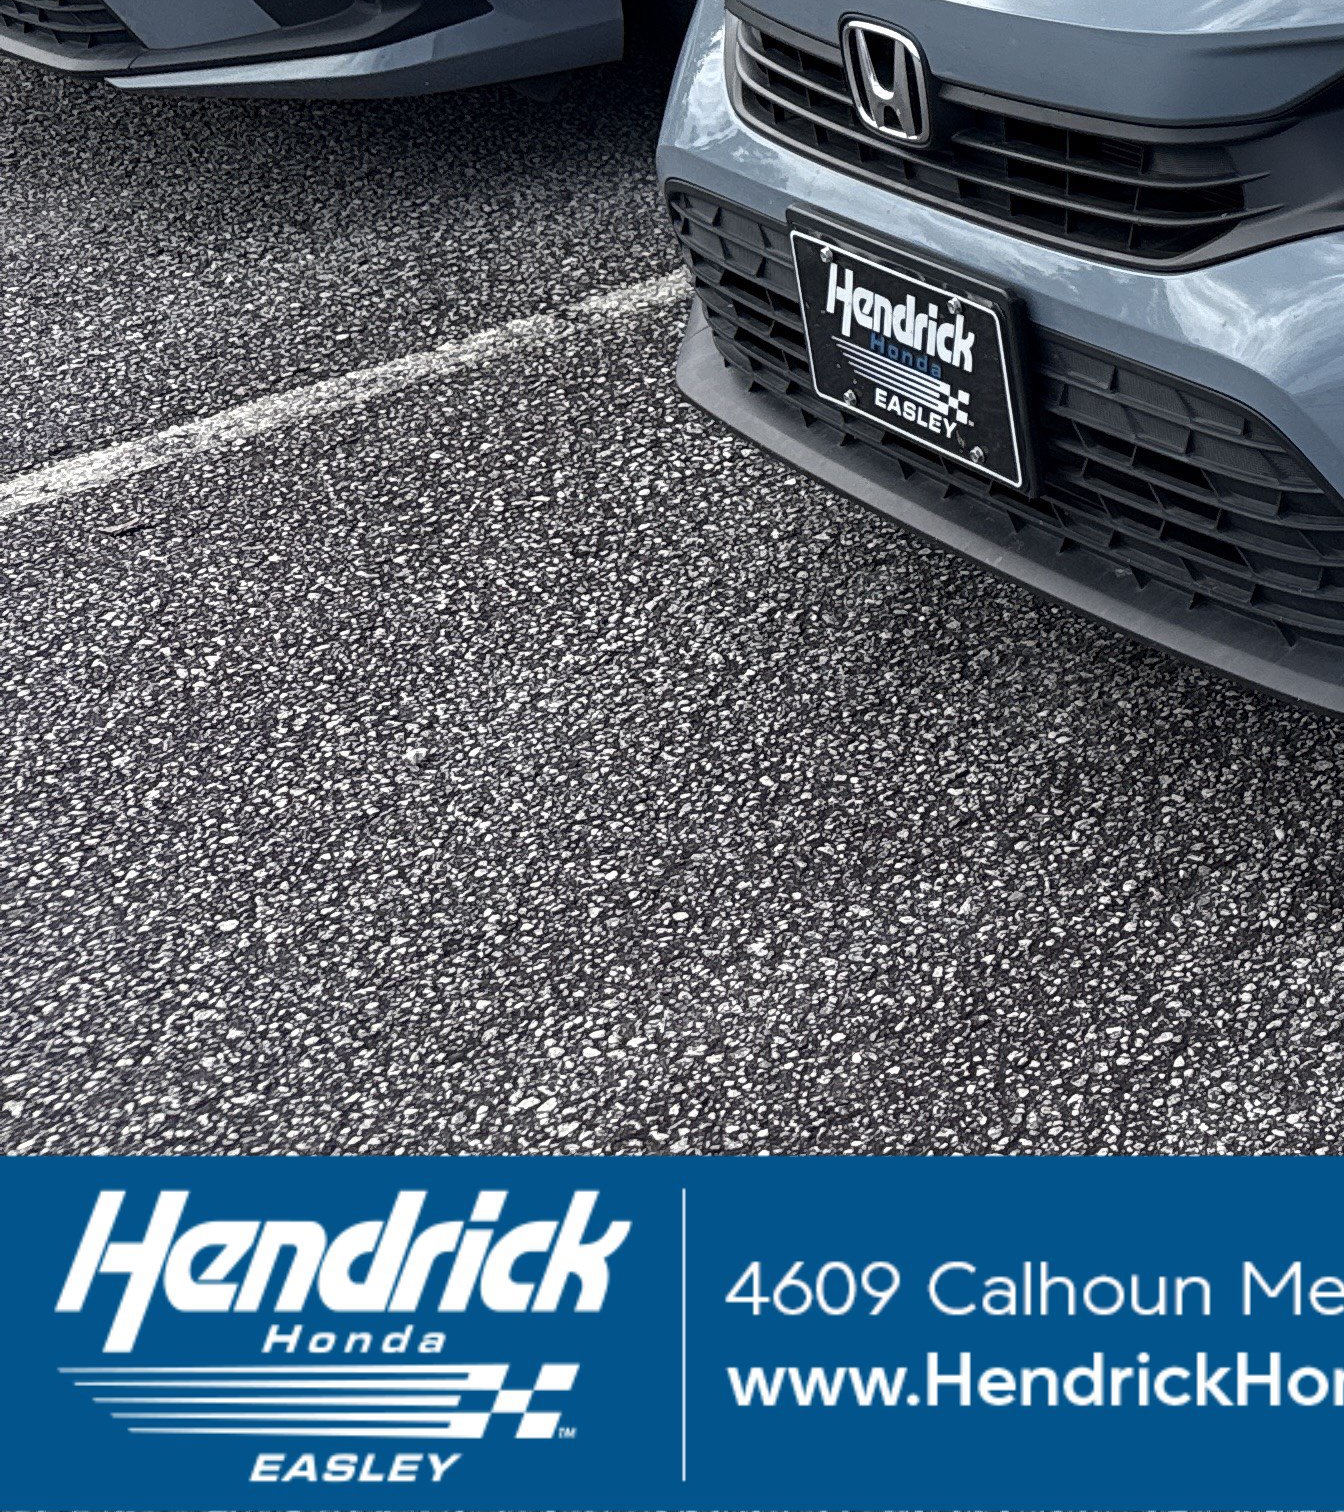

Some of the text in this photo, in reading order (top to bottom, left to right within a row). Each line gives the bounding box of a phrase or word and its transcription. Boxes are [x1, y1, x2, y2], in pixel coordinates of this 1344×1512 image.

[825, 262, 976, 373] Hendrick
[869, 333, 942, 379] Honda
[874, 387, 958, 439] EASLEY
